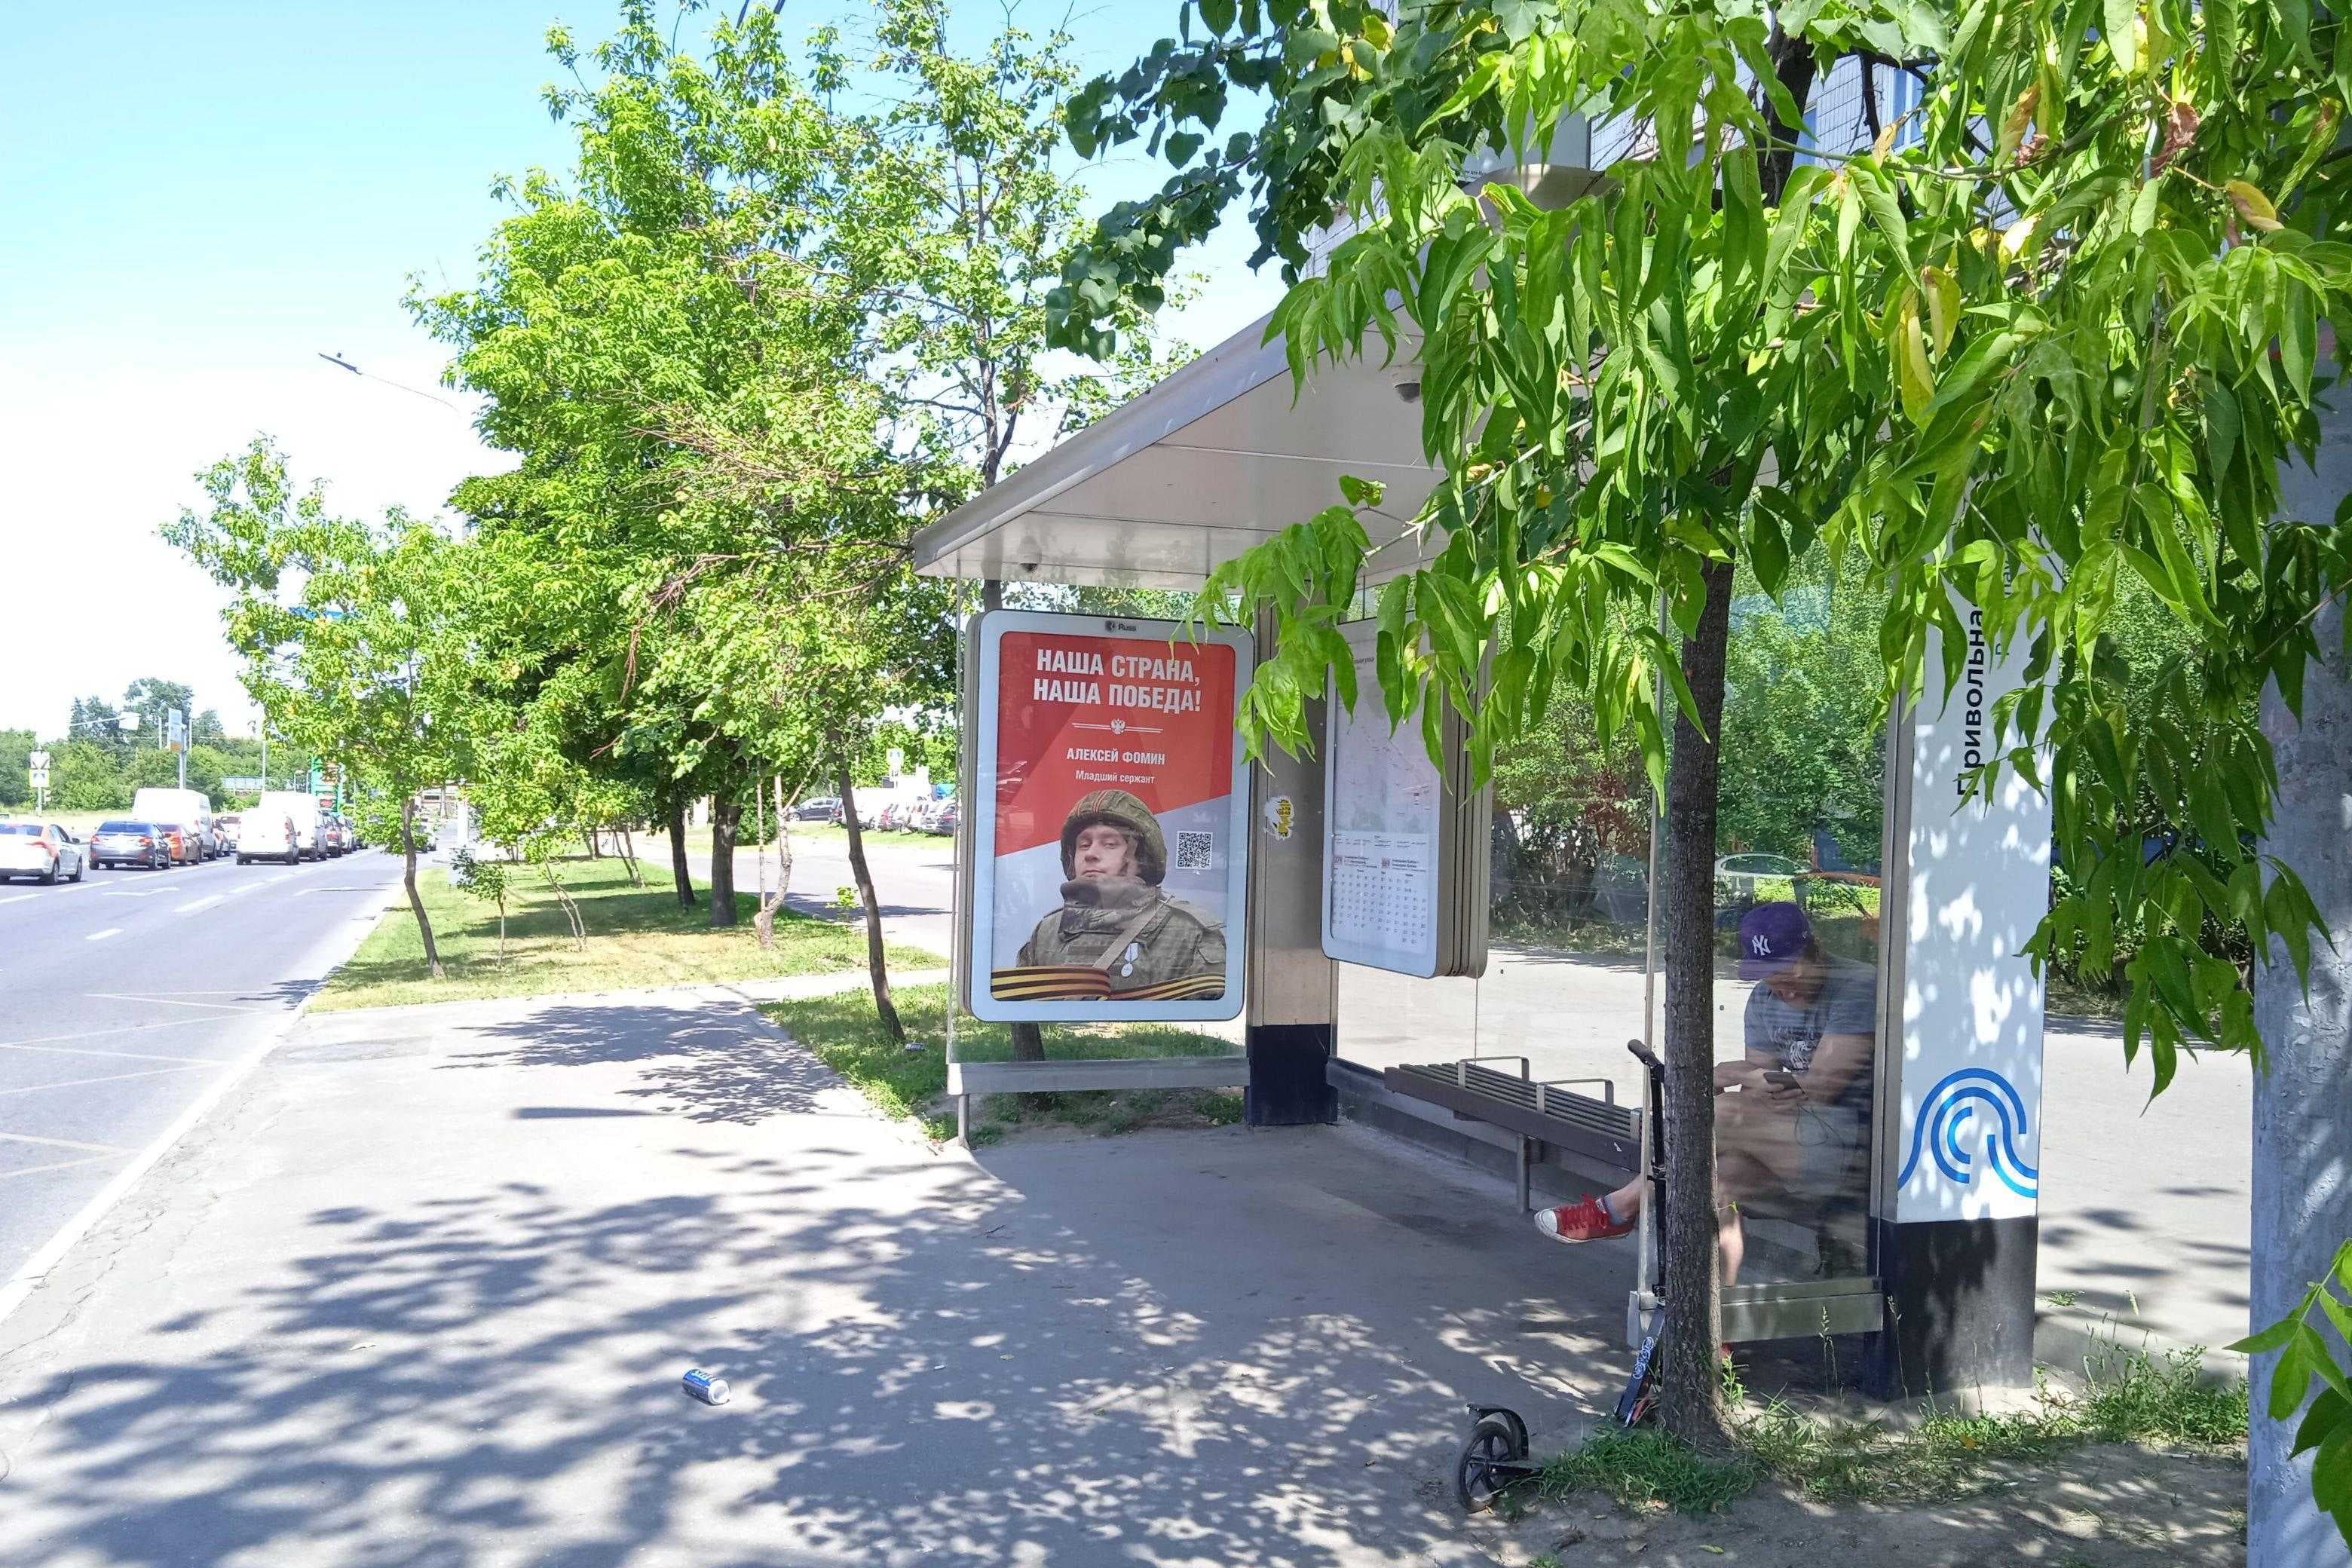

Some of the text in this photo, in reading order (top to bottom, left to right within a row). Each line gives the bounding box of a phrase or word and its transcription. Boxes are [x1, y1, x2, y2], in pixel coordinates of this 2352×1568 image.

[1037, 648, 1200, 686] НАША СТРАНА,
[1033, 678, 1201, 714] НАША ПОБЕДА!
[1957, 602, 1985, 795] Привольна
[1066, 747, 1165, 765] АЛЕКСЕЙ ФОМИН
[1075, 770, 1156, 785] Младший сержант
[1751, 935, 1772, 956] NY
